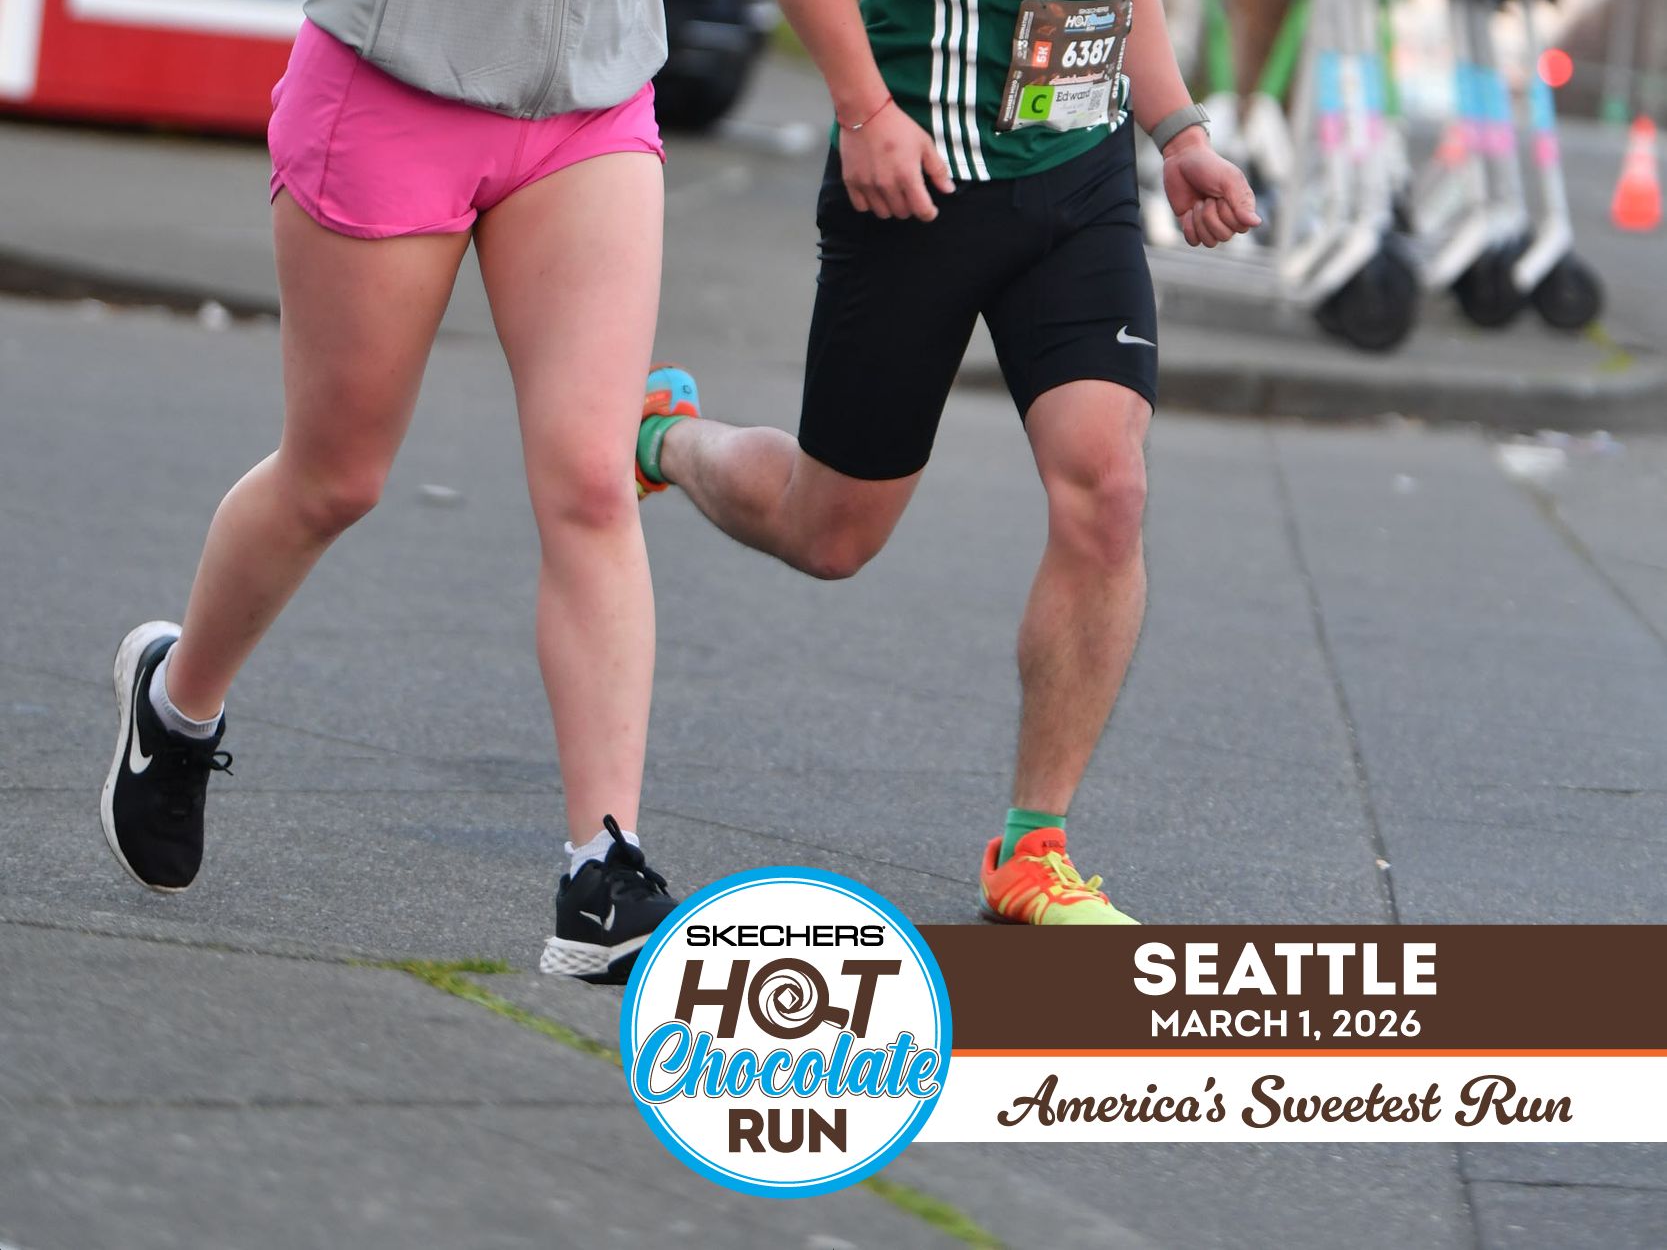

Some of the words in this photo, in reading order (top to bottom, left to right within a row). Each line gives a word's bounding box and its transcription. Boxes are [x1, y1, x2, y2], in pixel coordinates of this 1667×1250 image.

[1037, 46, 1050, 64] 5K
[1061, 36, 1116, 69] 6387
[1031, 94, 1047, 114] C
[1055, 88, 1092, 103] Edward
